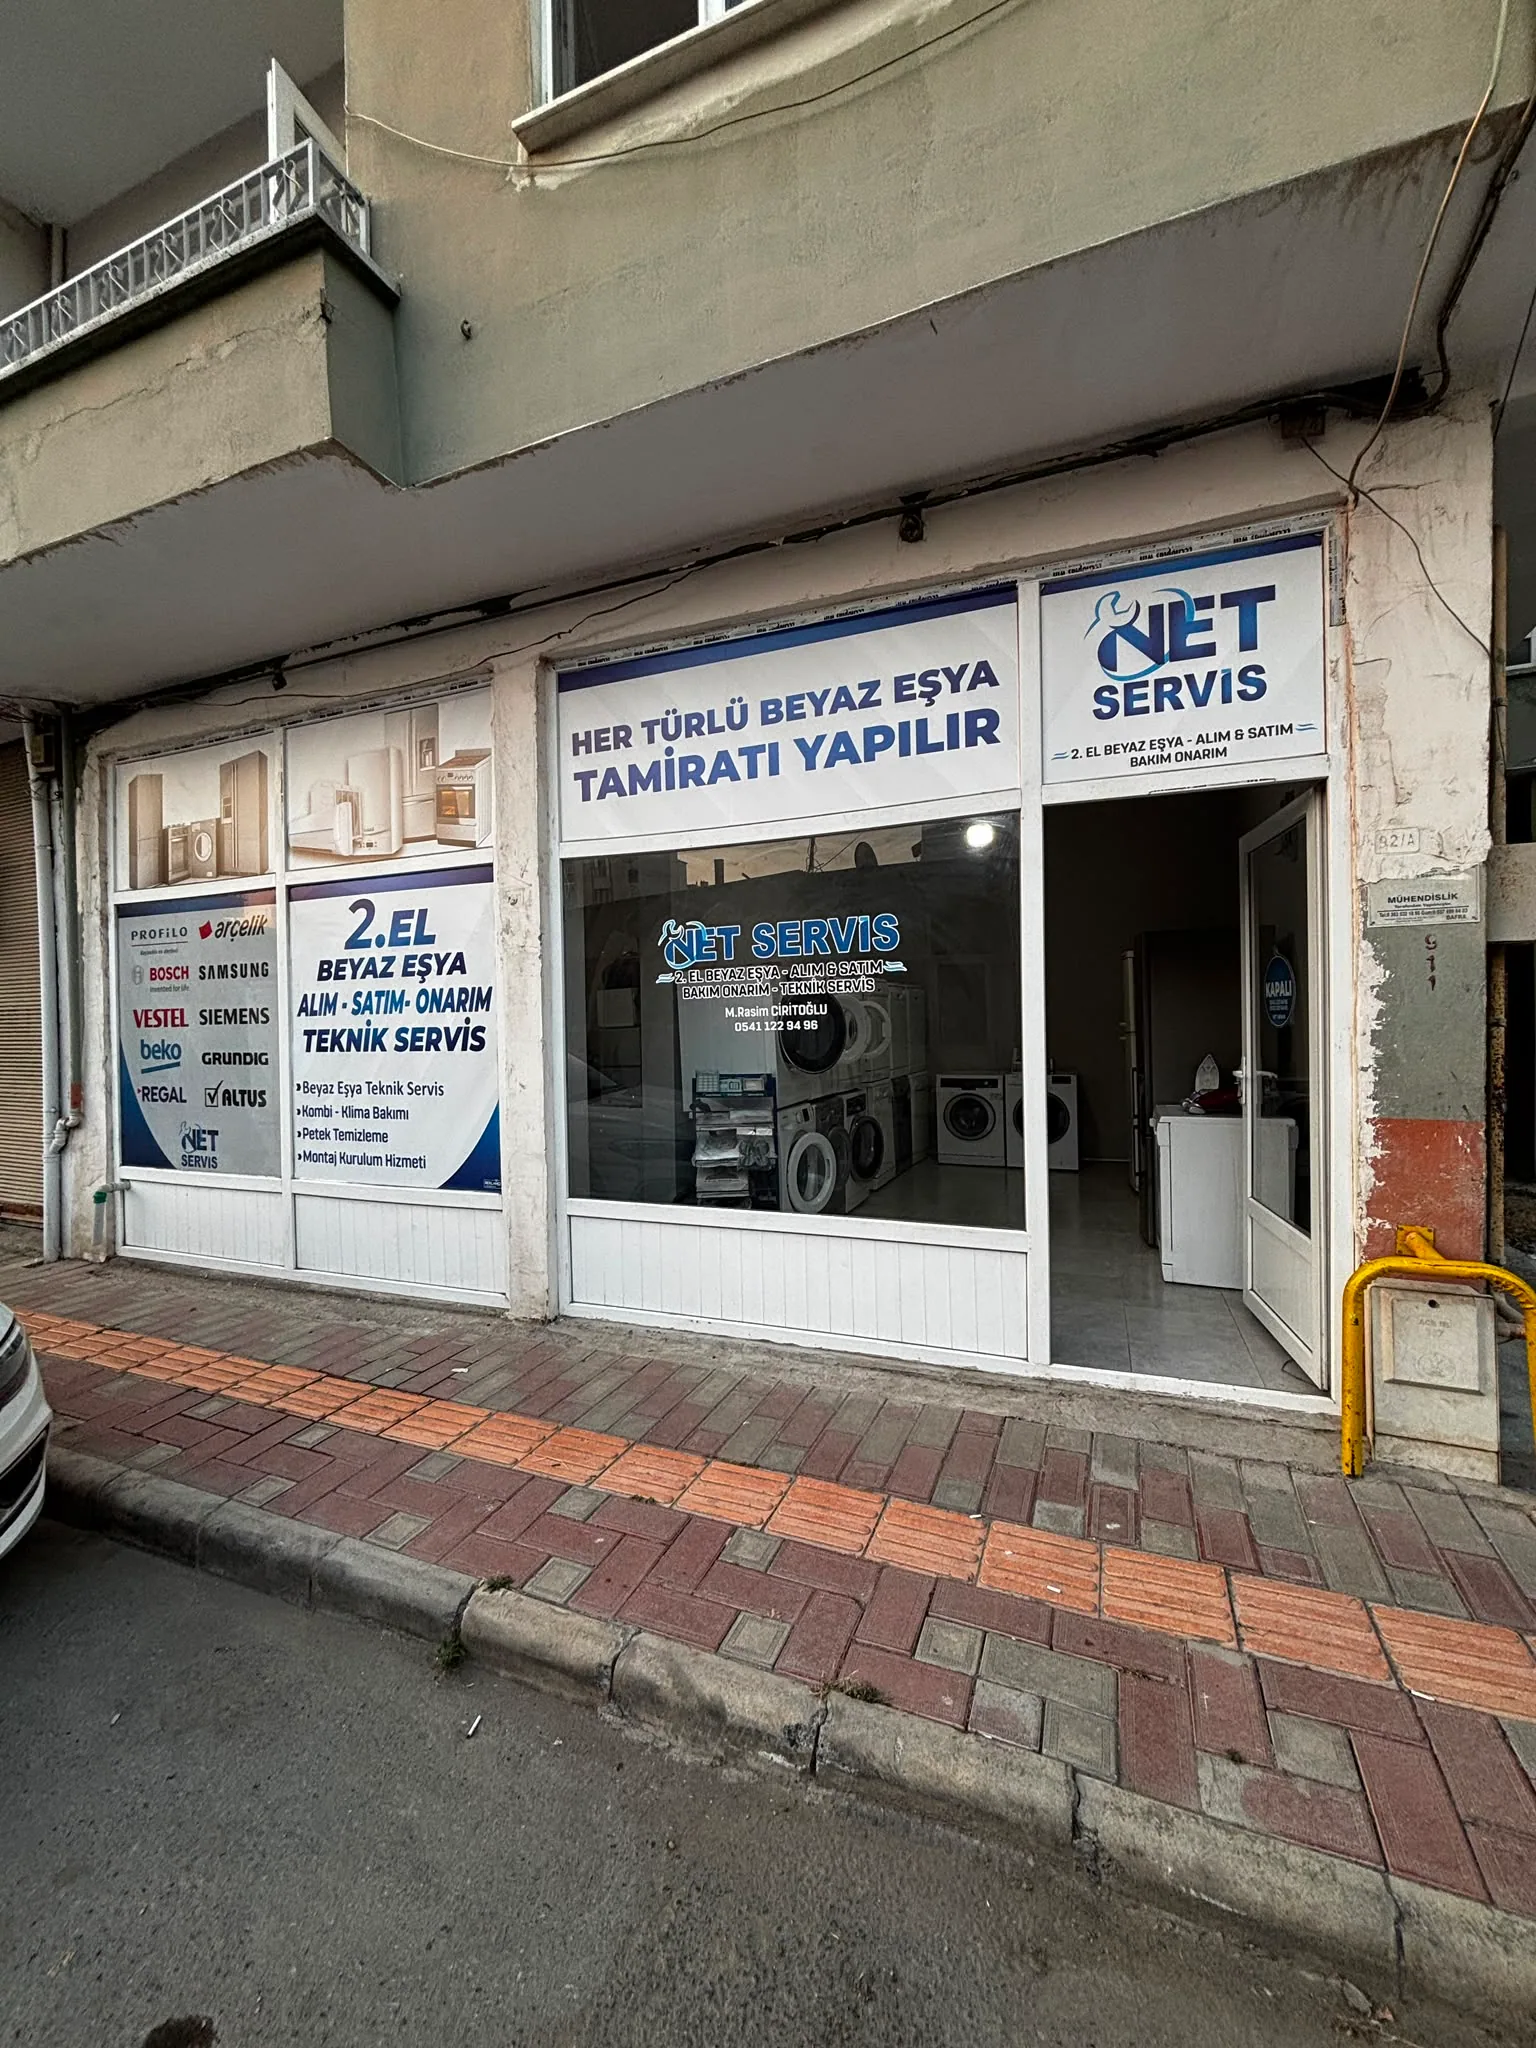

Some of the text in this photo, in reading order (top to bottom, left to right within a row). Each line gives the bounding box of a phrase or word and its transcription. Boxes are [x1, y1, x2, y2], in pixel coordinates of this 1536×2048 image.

[1097, 584, 1276, 681] NET
[572, 660, 1000, 756] HER TÜRLÜ BEYAZ EŞYA
[1071, 749, 1083, 760] 2.
[1086, 746, 1101, 758] EL
[1104, 740, 1146, 756] BEYAZ
[1149, 737, 1184, 754] EŞYA
[1196, 730, 1231, 745] ALIM
[1235, 729, 1244, 740] &
[1248, 723, 1294, 739] SATIM
[574, 707, 1001, 803] TAMİRATI YAPILIR
[1130, 747, 1227, 767] BAKIM ONARIM
[1387, 892, 1459, 903] MÜHENDİSLİK
[214, 914, 268, 942] arçelik
[344, 899, 436, 950] 2.EL
[664, 924, 741, 969] NET
[149, 965, 189, 981] BOSCH
[198, 962, 269, 980] SAMSUNG
[317, 952, 467, 983] BEYAZ EŞYA
[675, 971, 686, 984] 2.
[689, 970, 703, 983] EL
[705, 967, 745, 982] BEYAZ
[747, 965, 780, 982] EŞYA
[789, 963, 827, 979] ALIM
[828, 963, 837, 976] &
[839, 960, 884, 976] SATIM
[682, 986, 720, 1000] BAKIM
[722, 983, 770, 997] ONARIM
[779, 978, 827, 996] TEKNİK
[827, 976, 875, 993] SERVİS
[1265, 980, 1292, 997] KAPALI
[297, 992, 338, 1017] ALIM
[416, 986, 493, 1013] ONARIM
[725, 1003, 828, 1018] M.Rasim CİRİTOĞLU
[133, 1008, 189, 1028] VESTEL
[199, 1008, 270, 1026] SIEMENS
[734, 1020, 818, 1032] 0541 122 94 96
[303, 1016, 486, 1053] TEKNİK SERVİS
[140, 1038, 182, 1060] beko
[202, 1052, 269, 1065] GRUNDIG
[142, 1086, 187, 1103] REGAL
[222, 1089, 267, 1107] ALTUS
[302, 1080, 445, 1098] Beyaz Eşya Teknik Servis
[302, 1105, 333, 1119] Kombi
[341, 1105, 370, 1120] Klima
[372, 1106, 409, 1120] Bakımı
[181, 1129, 219, 1153] NET
[302, 1127, 389, 1143] Petek Temizleme
[303, 1151, 427, 1169] Montaj Kurulum Hizmeti
